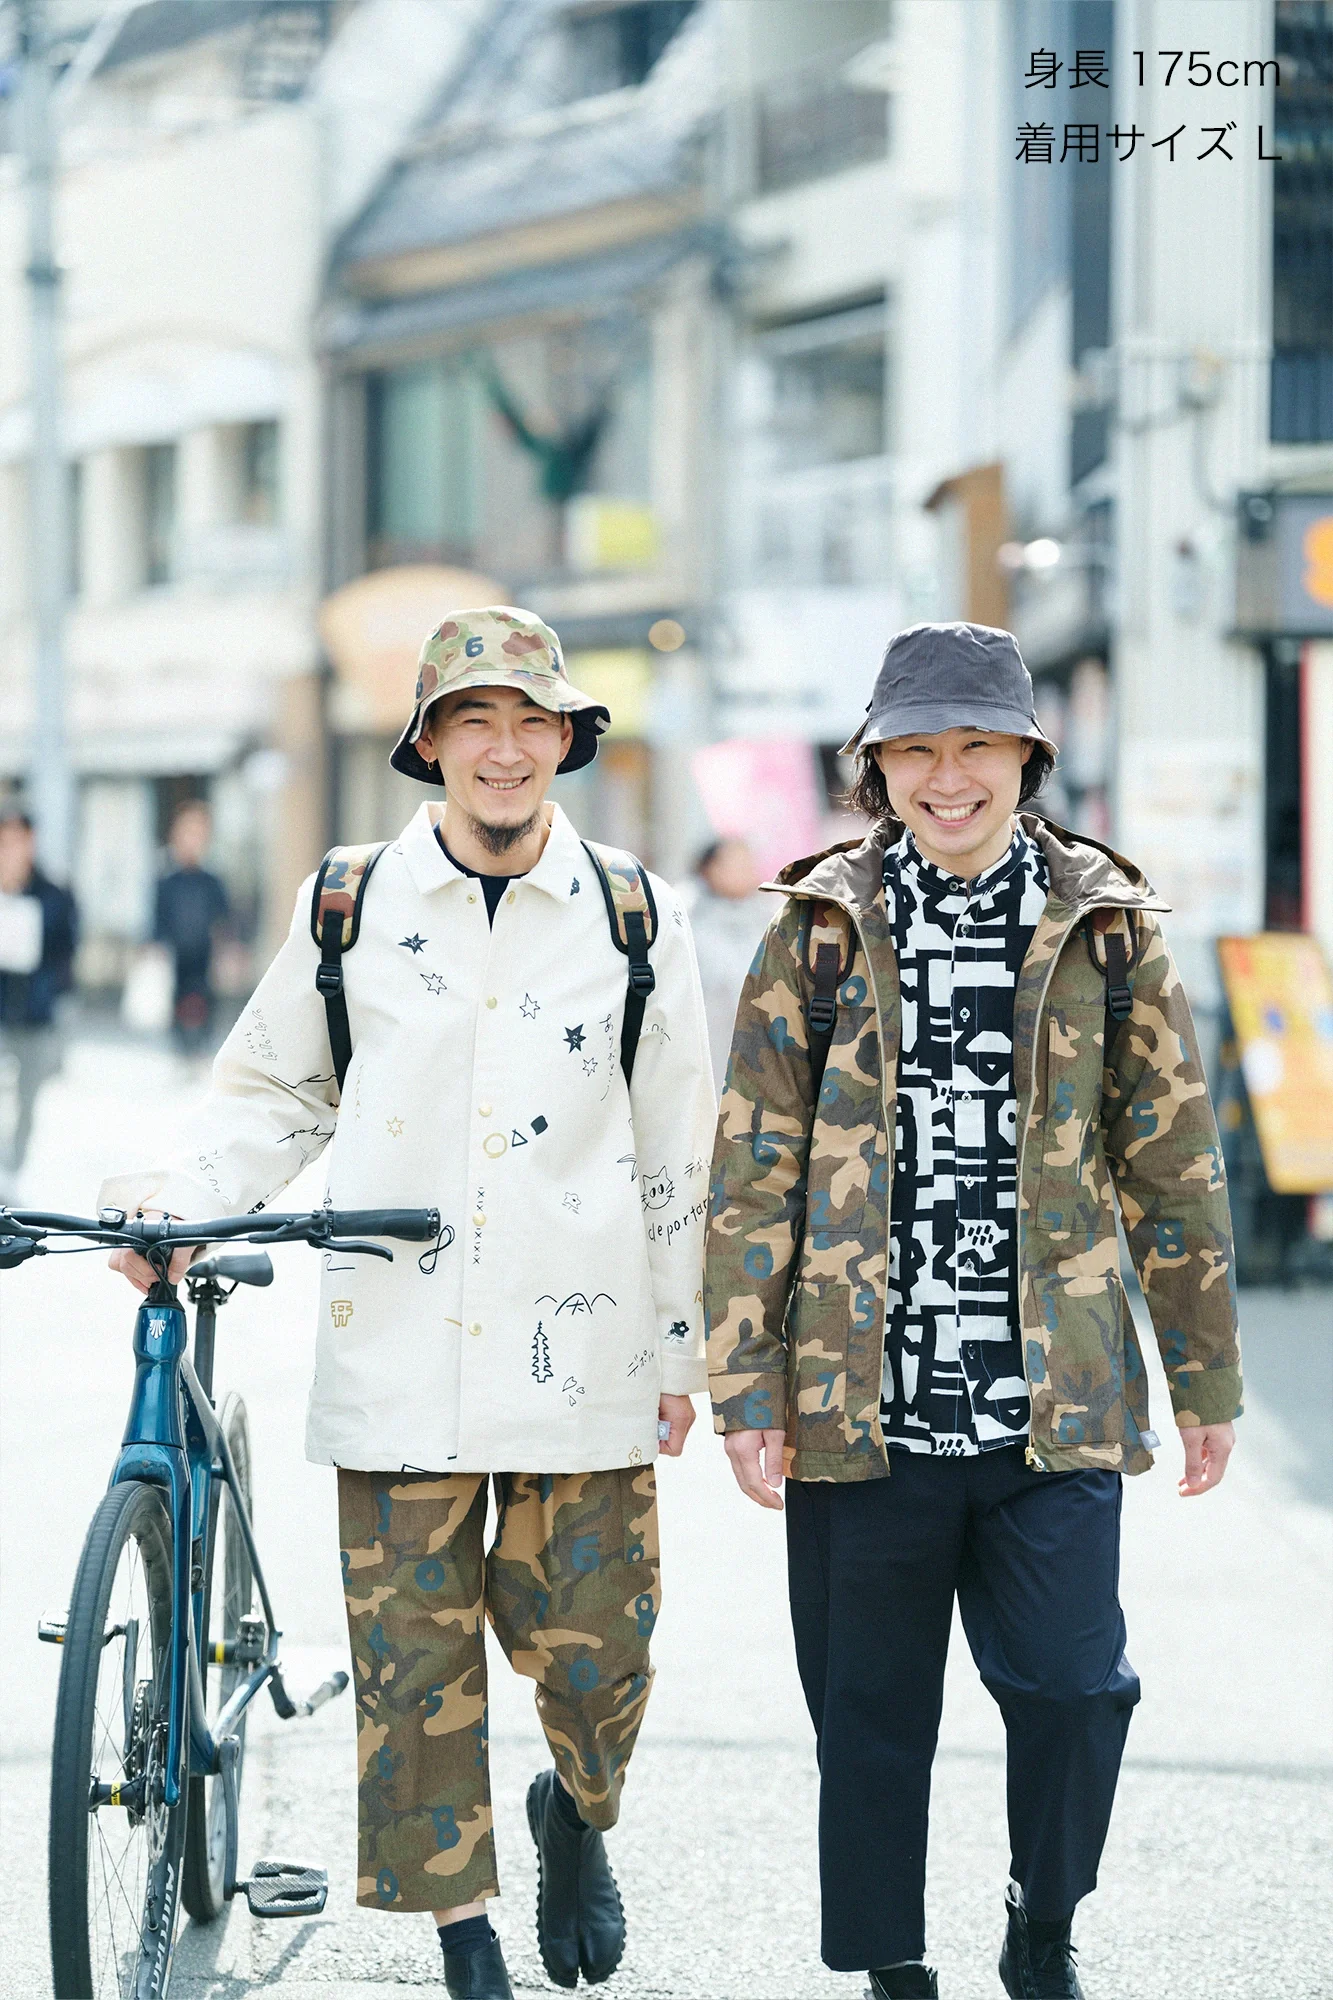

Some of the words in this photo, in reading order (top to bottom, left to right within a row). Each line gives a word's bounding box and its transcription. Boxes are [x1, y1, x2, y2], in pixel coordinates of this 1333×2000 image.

[465, 636, 485, 658] 6
[840, 975, 868, 1008] 0
[769, 1016, 795, 1053] 4
[819, 1067, 841, 1105] 6
[1055, 1082, 1076, 1121] 5
[1131, 1101, 1159, 1138] 5
[753, 1133, 781, 1166] 6
[810, 1190, 831, 1226] 2
[1156, 1219, 1187, 1260] 8
[743, 1246, 774, 1280] 0
[855, 1292, 876, 1330] 5
[816, 1371, 836, 1408] 7
[743, 1389, 773, 1429] 6
[571, 1535, 601, 1573] 6
[414, 1559, 445, 1592] 0
[635, 1593, 656, 1638] 8
[568, 1658, 599, 1692] 0
[425, 1681, 446, 1719] 5
[432, 1805, 461, 1850] 8
[376, 1867, 399, 1903] 0
